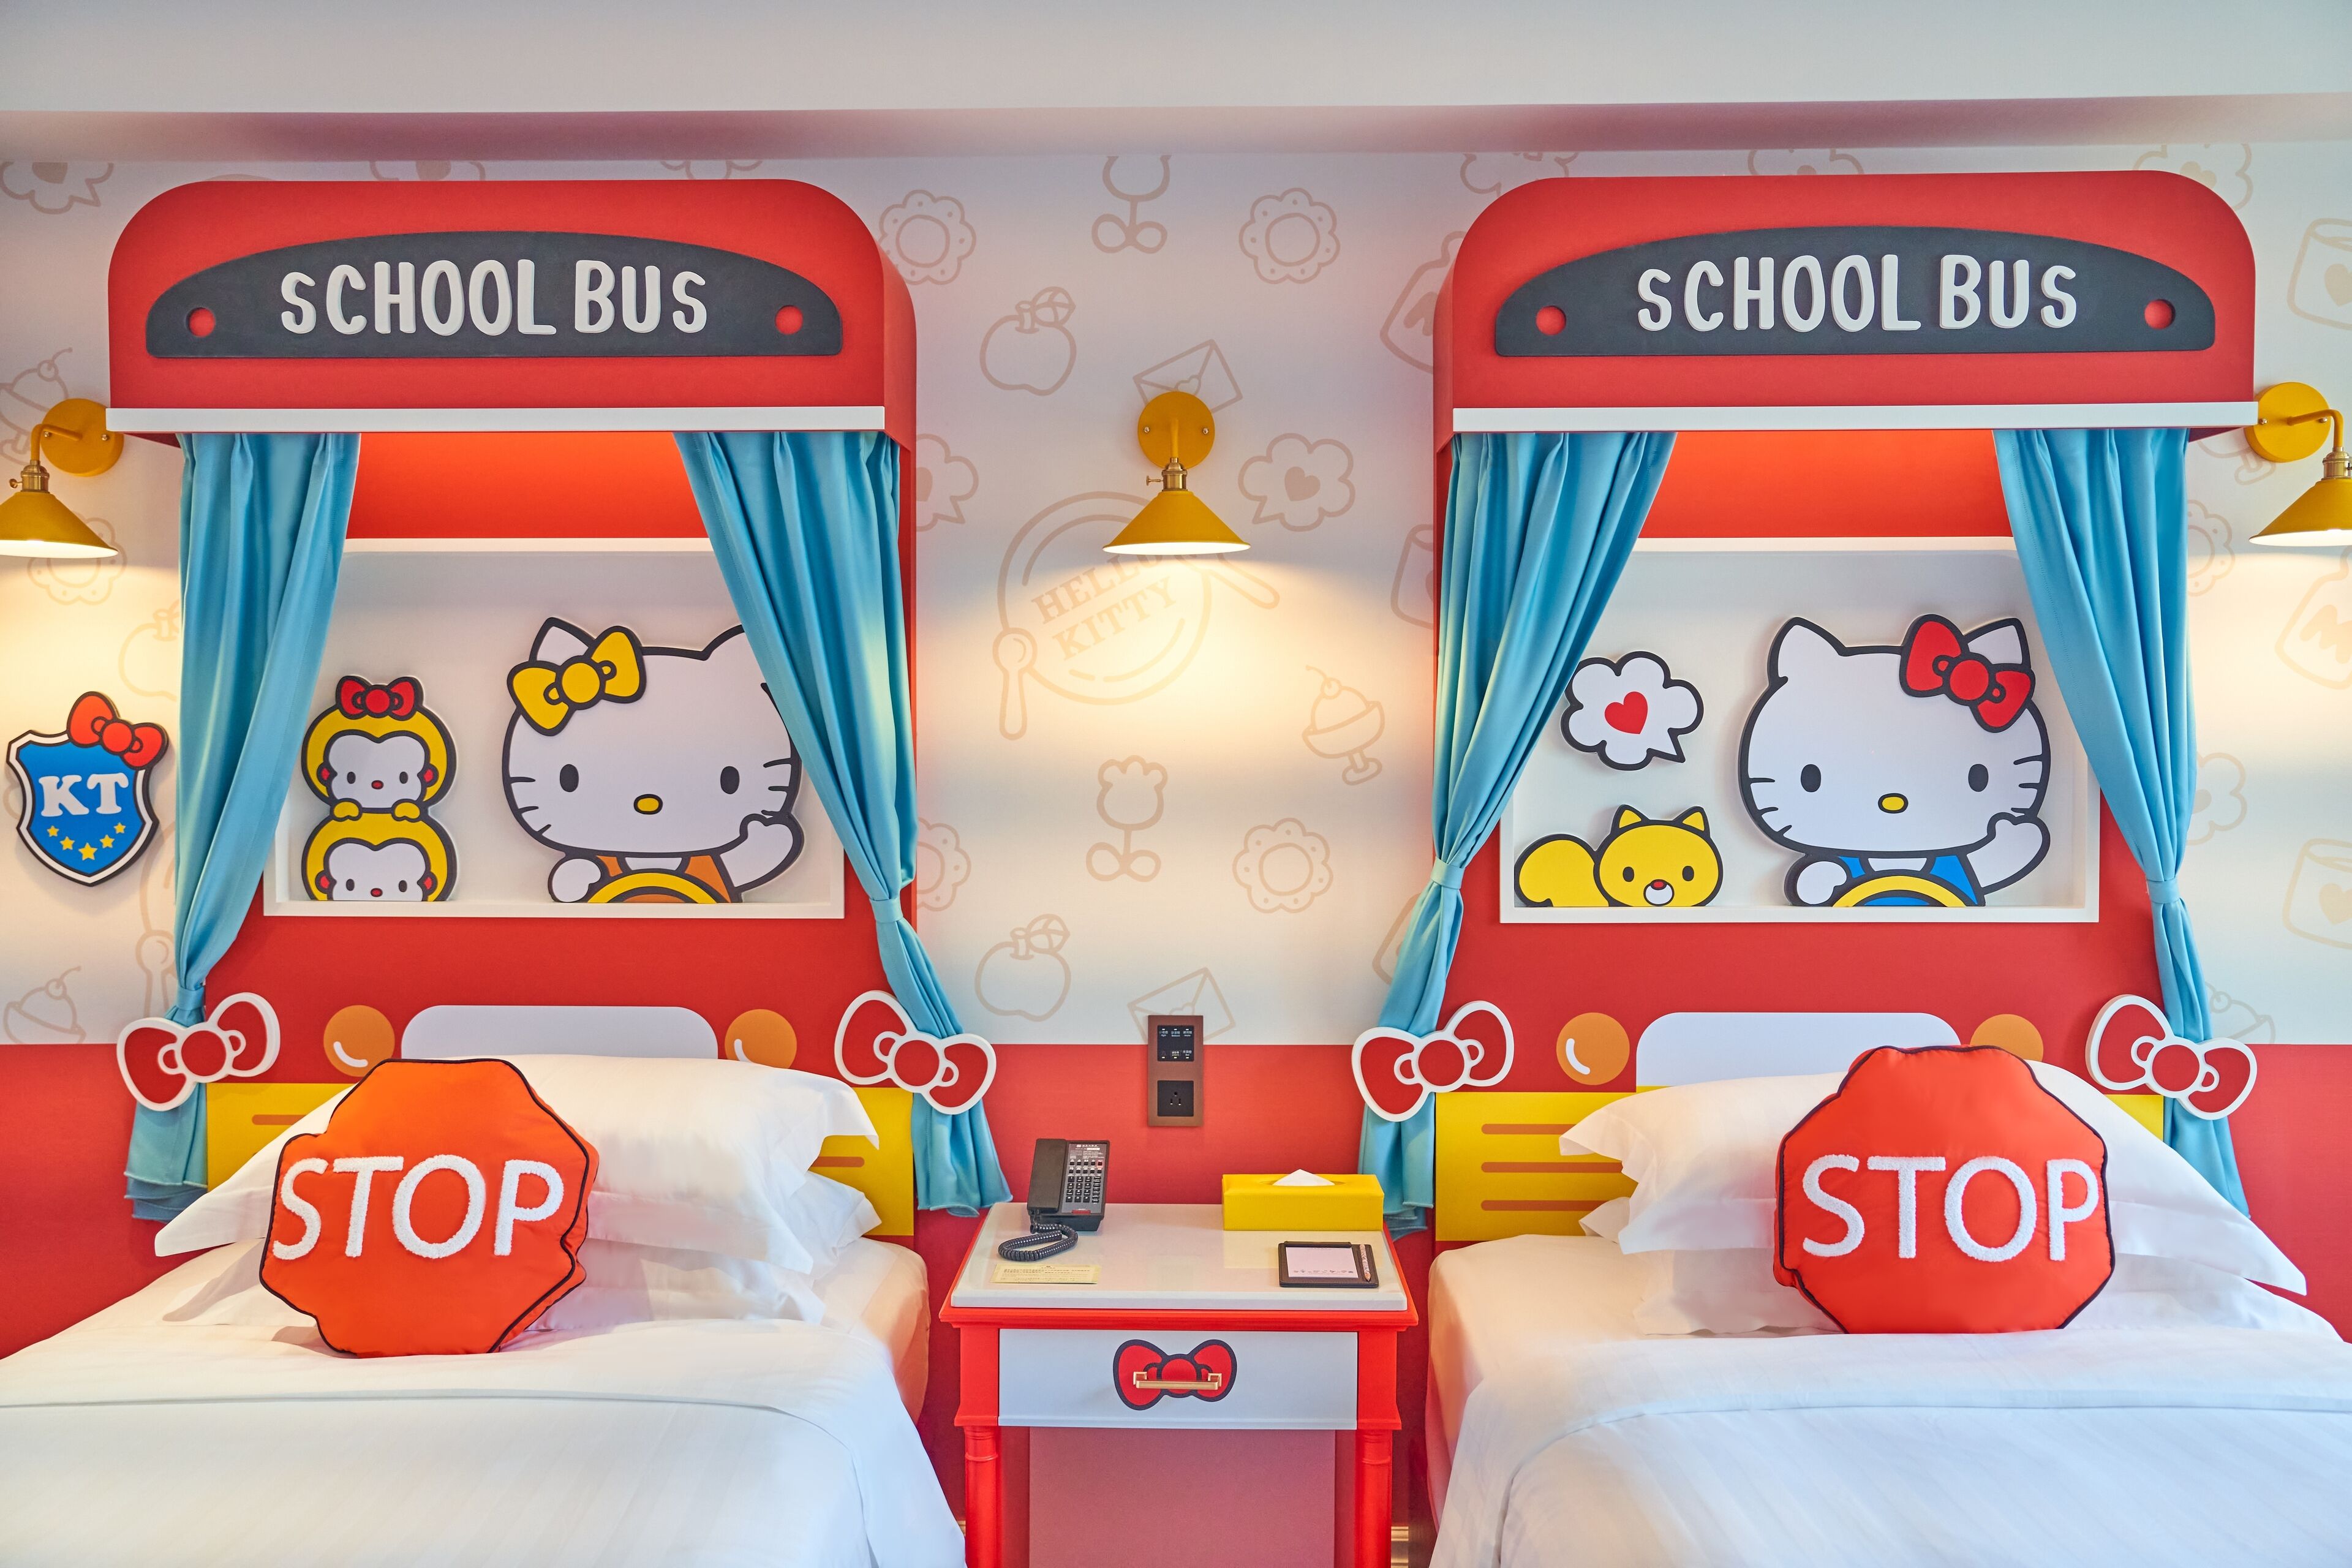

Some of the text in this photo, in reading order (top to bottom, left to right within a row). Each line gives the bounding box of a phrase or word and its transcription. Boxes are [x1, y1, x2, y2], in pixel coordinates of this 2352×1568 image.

[281, 259, 707, 336] SCHOOL BUS
[1637, 254, 2077, 332] SCHOOL BUS
[1052, 576, 1177, 661] KITTY
[273, 1154, 564, 1260] STOP
[1802, 1154, 2099, 1262] STOP
